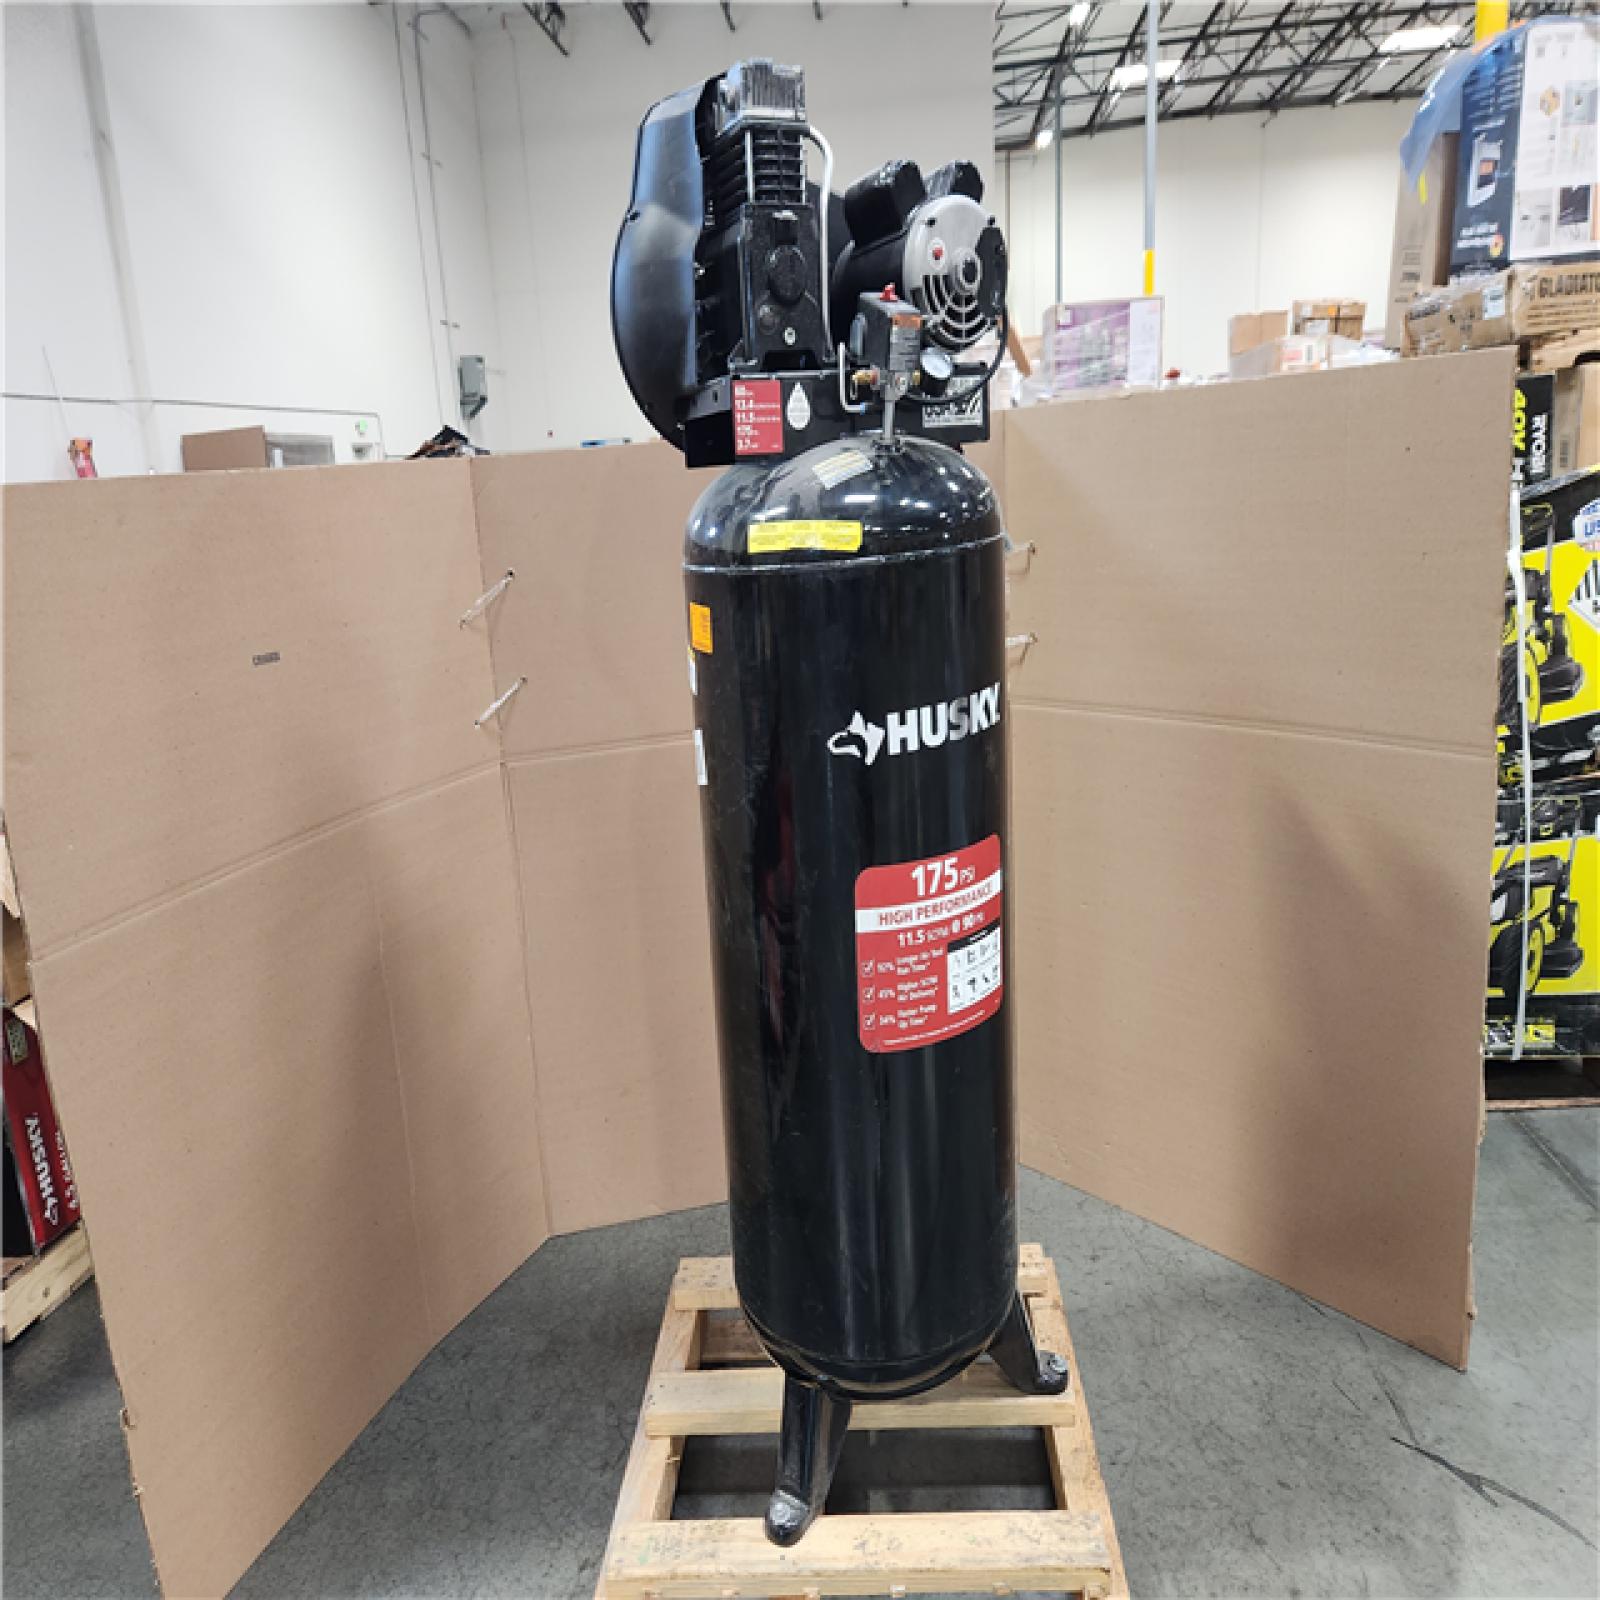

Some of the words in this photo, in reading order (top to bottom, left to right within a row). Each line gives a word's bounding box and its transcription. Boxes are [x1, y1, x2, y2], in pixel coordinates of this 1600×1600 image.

[887, 682, 1000, 756] HUSKY
[911, 856, 958, 897] 175
[878, 908, 913, 926] HIGH
[917, 880, 993, 921] PERFORMANCE
[897, 930, 926, 948] 11.5
[25, 1117, 54, 1198] HUSKY
